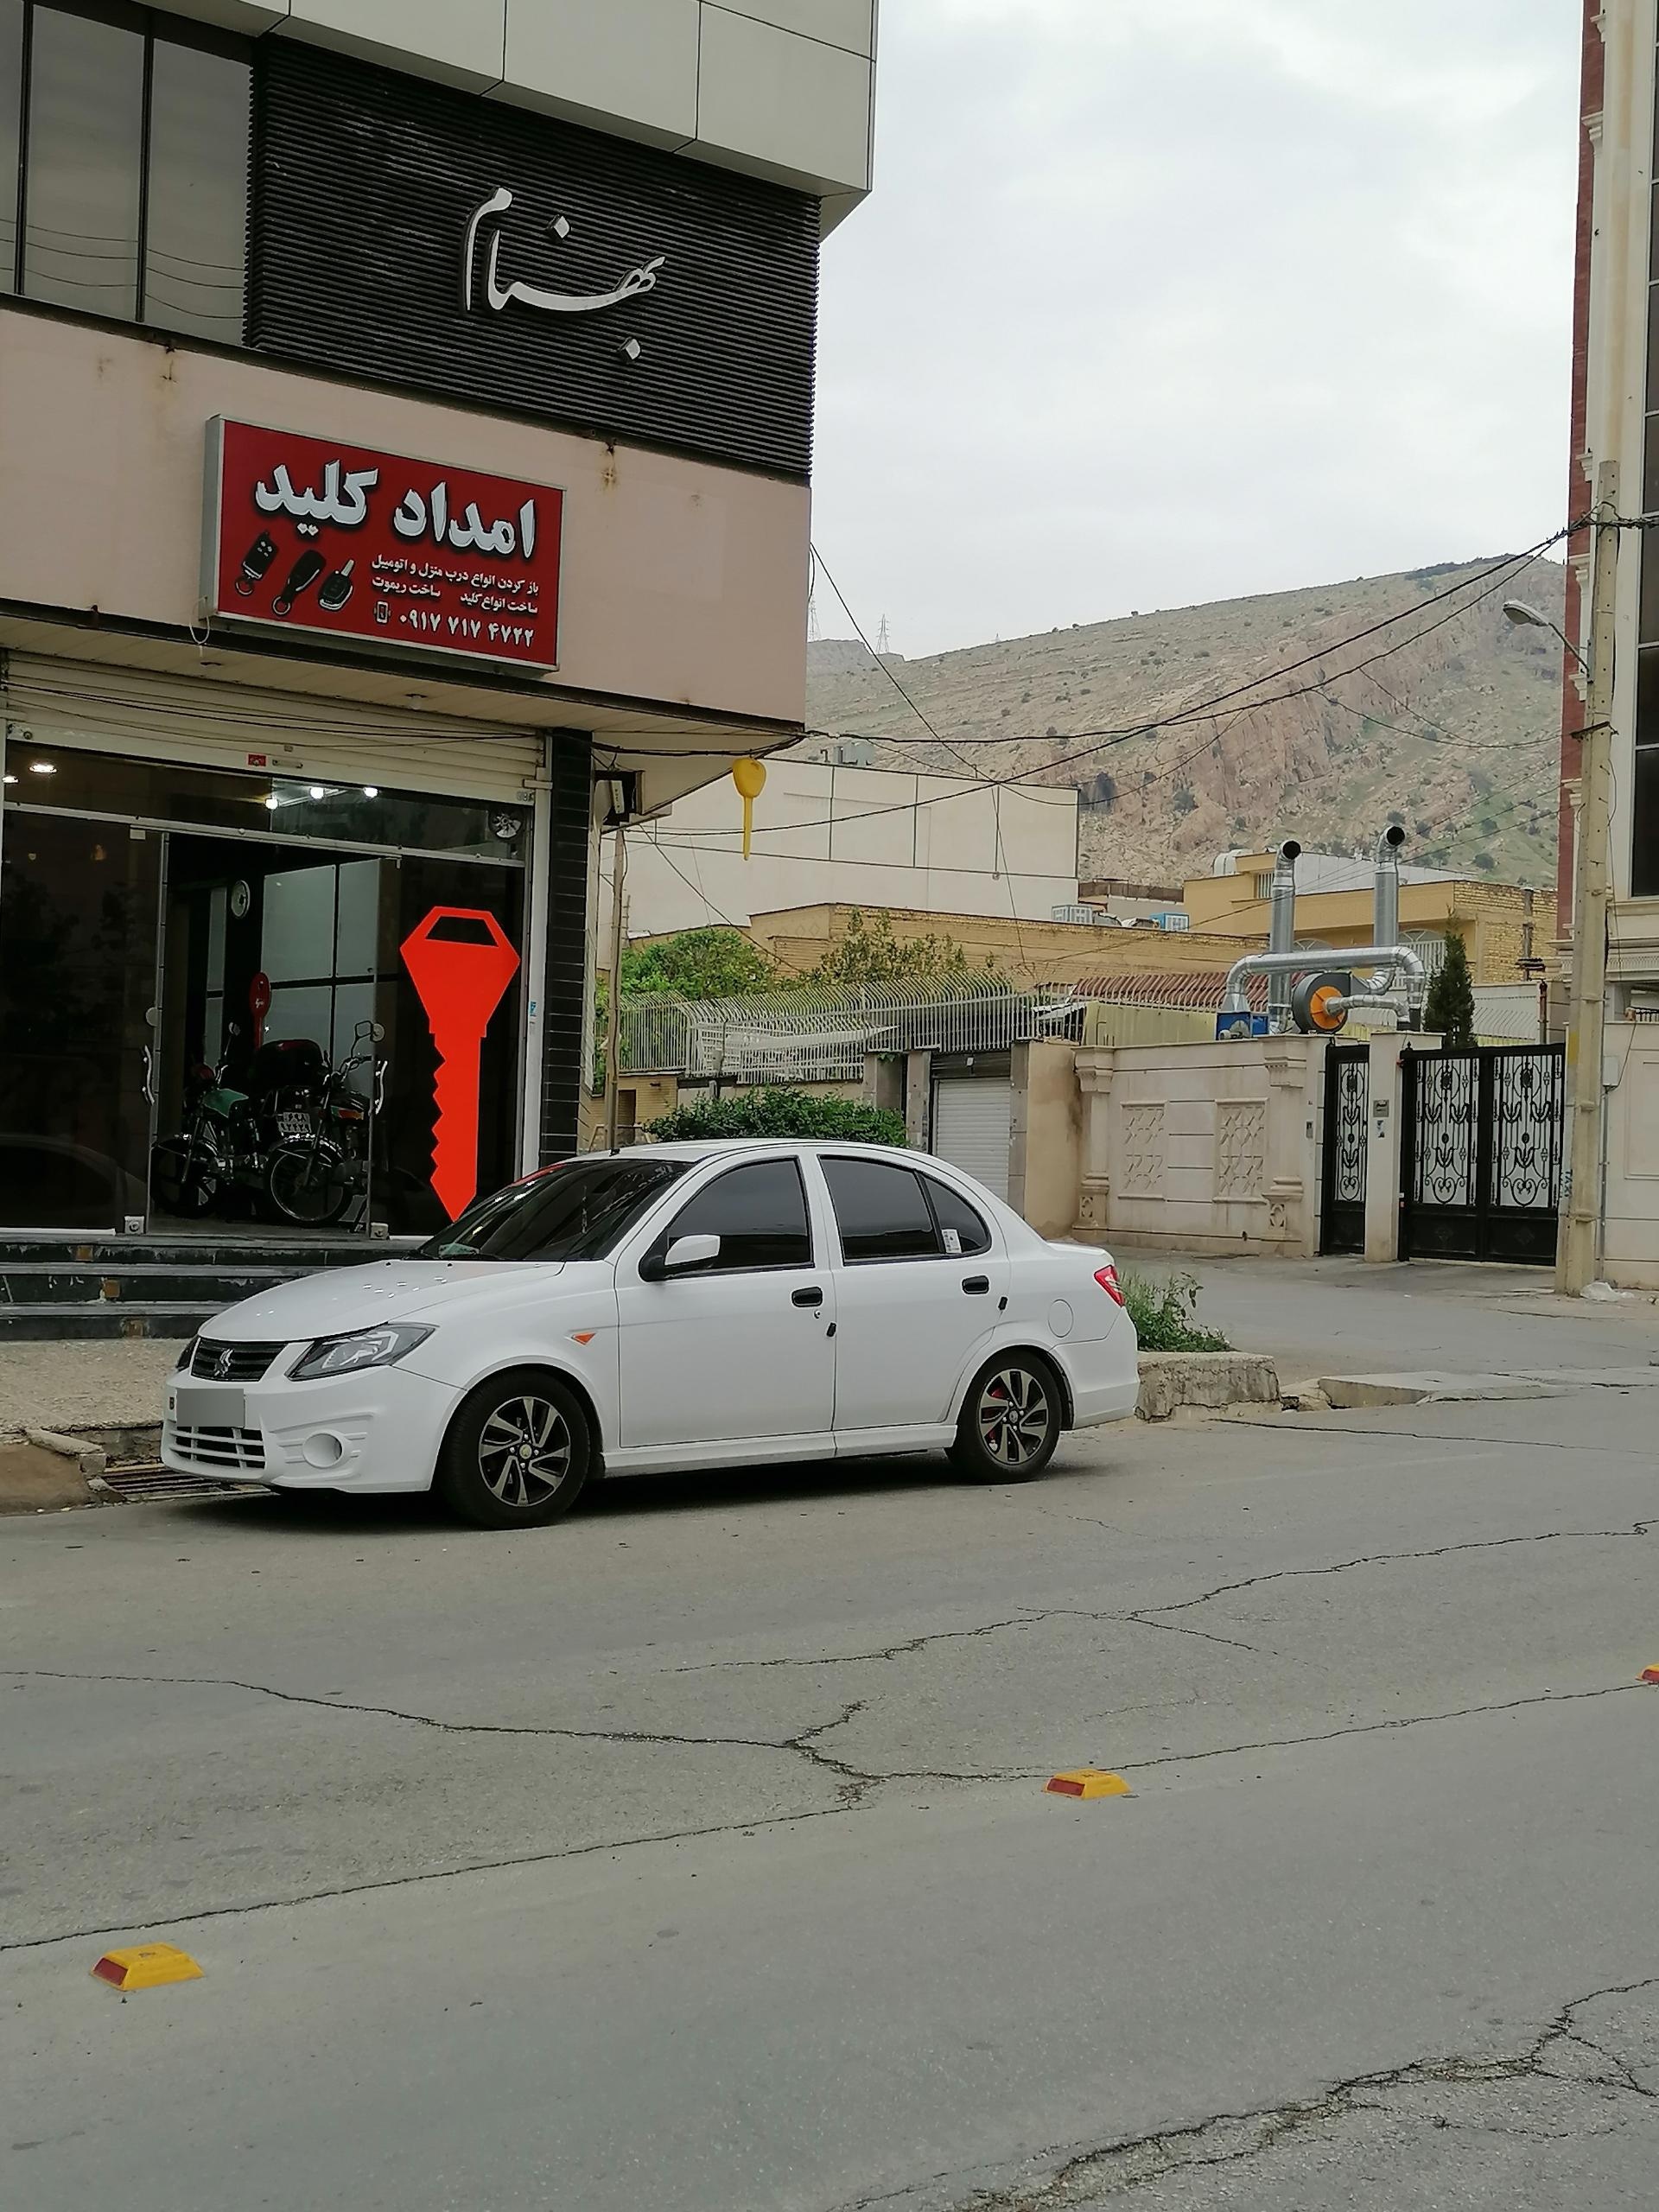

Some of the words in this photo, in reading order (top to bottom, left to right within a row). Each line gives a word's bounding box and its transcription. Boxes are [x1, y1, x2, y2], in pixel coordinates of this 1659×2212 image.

[256, 459, 379, 537] کلید
[393, 480, 536, 559] امداد
[372, 554, 408, 573] اتومبیل
[410, 563, 416, 575] و
[418, 563, 442, 579] منزل
[445, 570, 469, 582] درب
[471, 573, 495, 588] انواع
[372, 575, 407, 594] ریموت
[409, 584, 441, 598] ساخت
[497, 578, 525, 594] کردن
[526, 582, 539, 596] باز
[460, 591, 483, 606] کلید
[481, 594, 505, 612] انواع
[507, 601, 538, 613] ساخت
[399, 609, 442, 632] ۰۹۱۷
[448, 615, 481, 639] ۷۱۷
[487, 622, 534, 647] ۴۷۲۲
